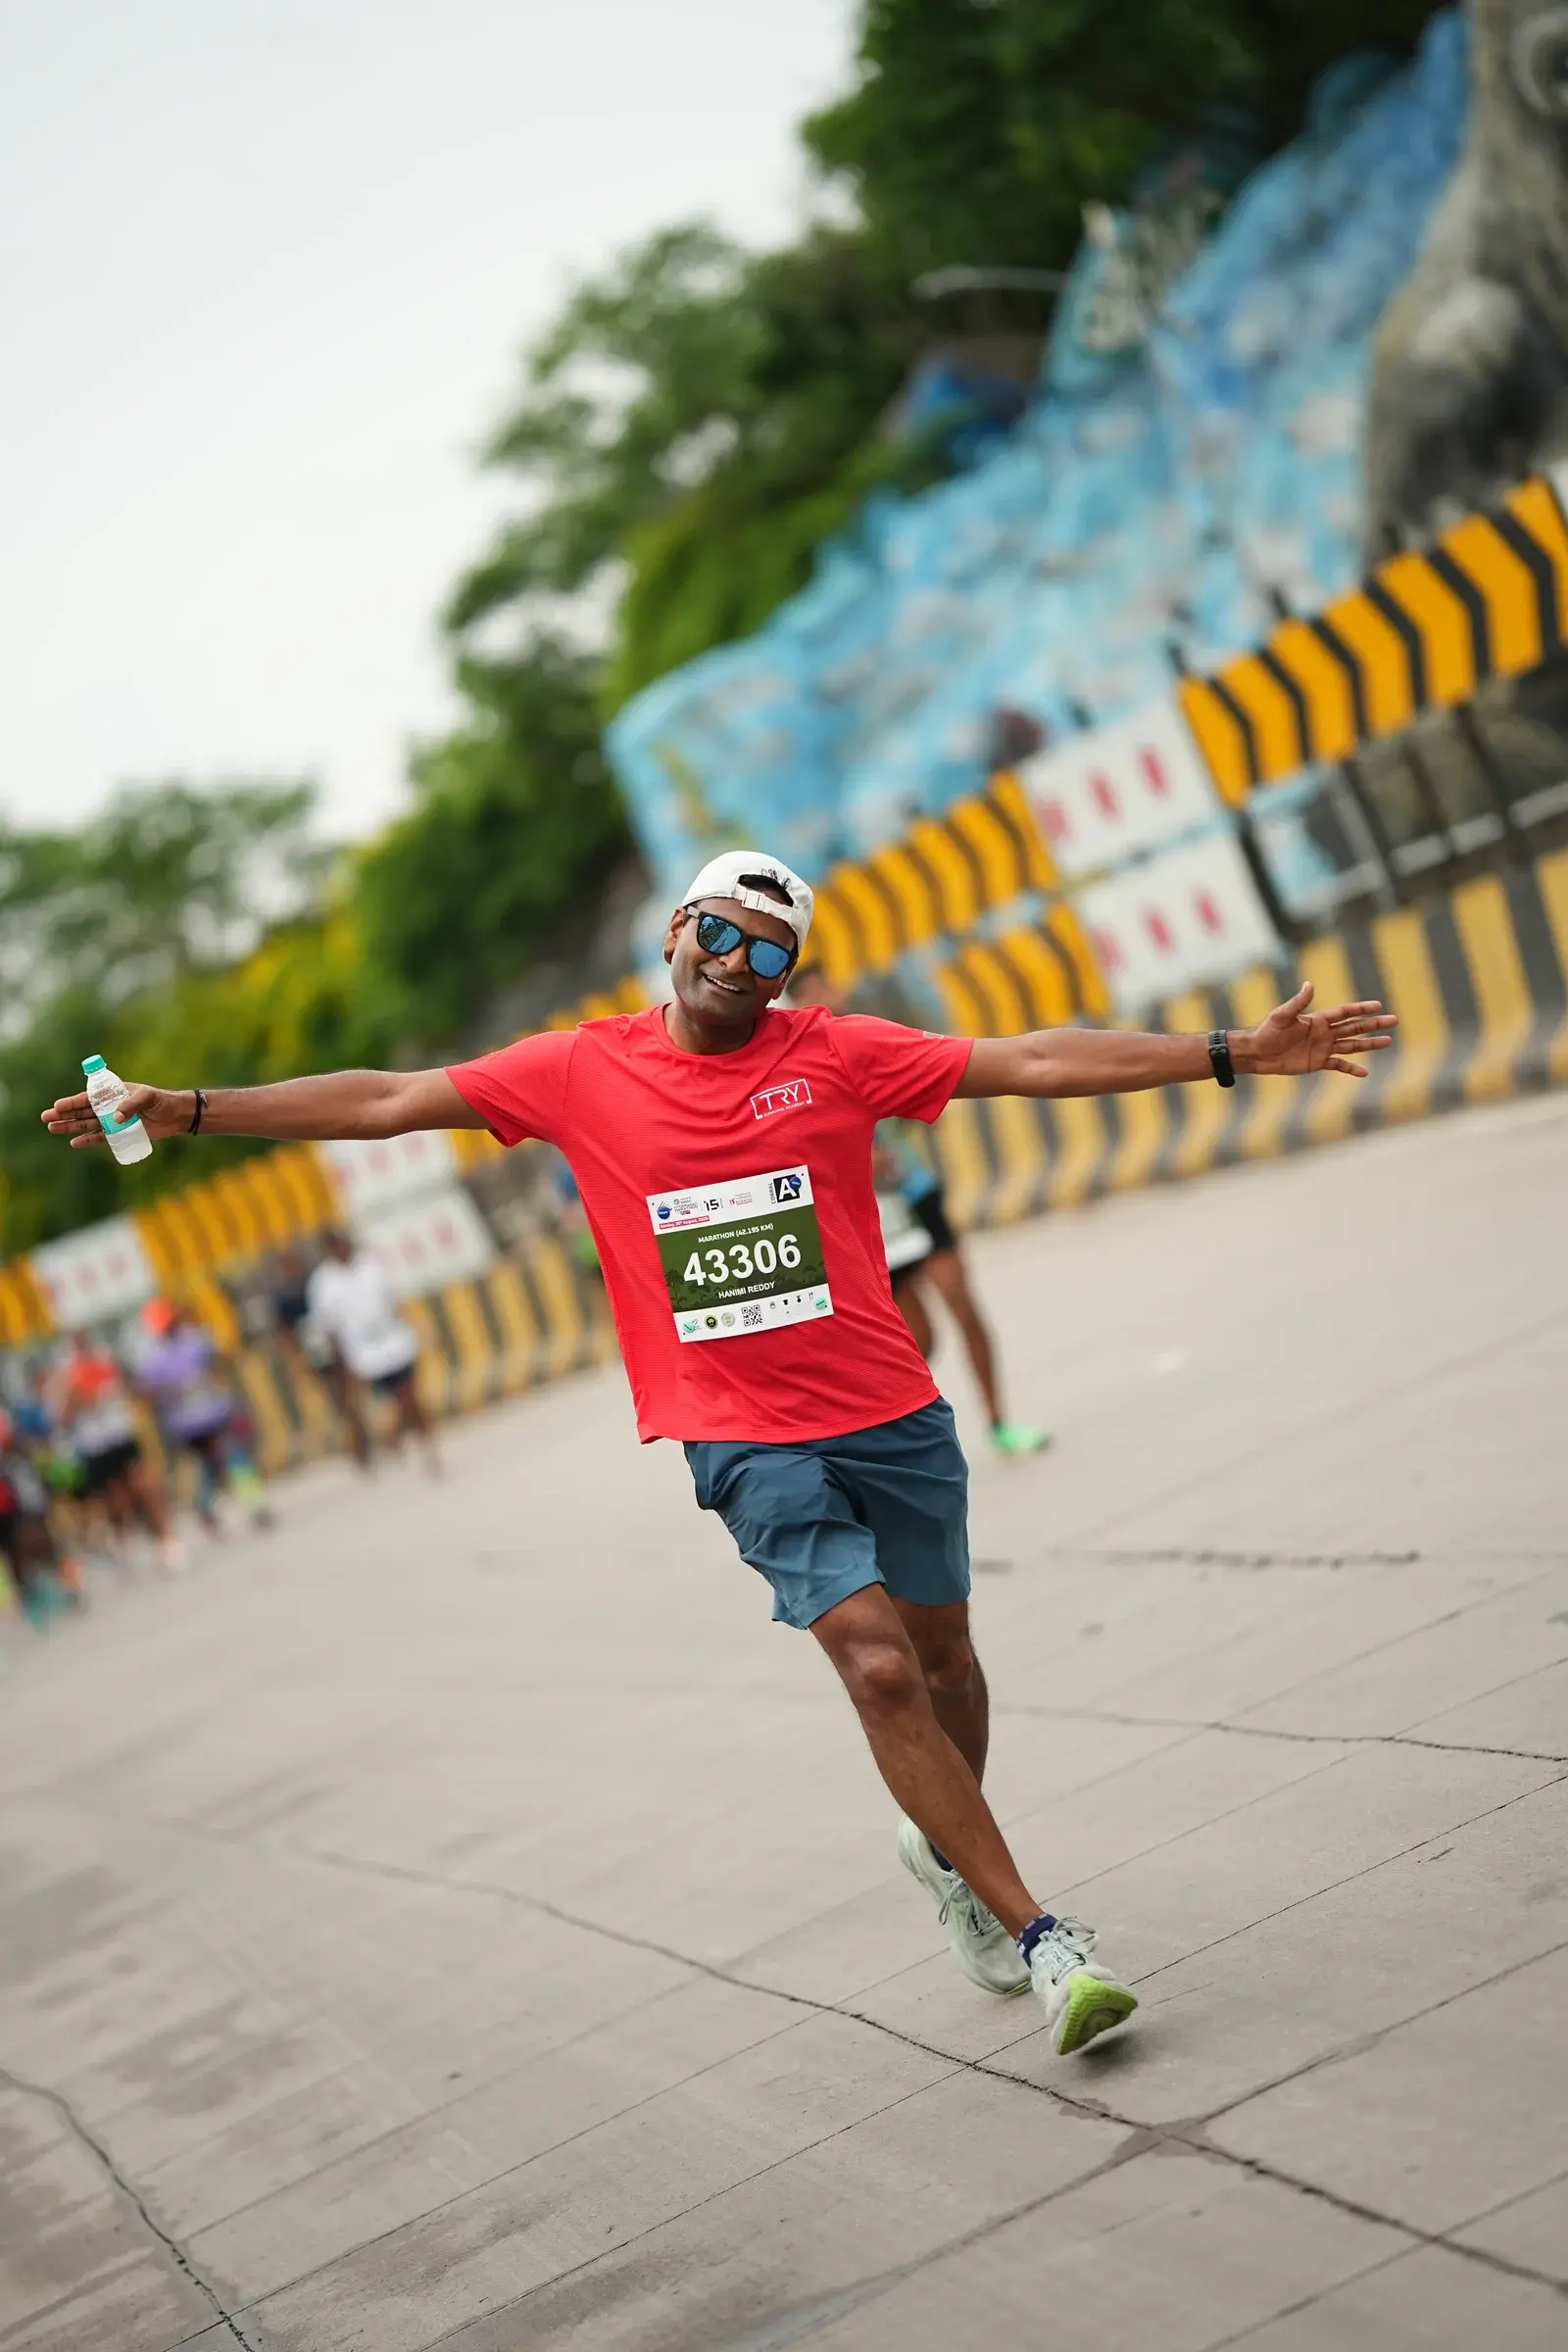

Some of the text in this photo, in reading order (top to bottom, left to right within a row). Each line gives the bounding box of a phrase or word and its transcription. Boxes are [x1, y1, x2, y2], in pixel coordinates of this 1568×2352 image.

[759, 1084, 799, 1110] TRY
[785, 1101, 806, 1110] ACADEMY
[767, 1182, 776, 1204] CORRAL
[778, 1178, 798, 1200] A
[698, 1222, 774, 1244] MARATHON (42.195 KM)
[683, 1234, 802, 1286] 43306
[718, 1281, 775, 1298] HANIMI REDDY
